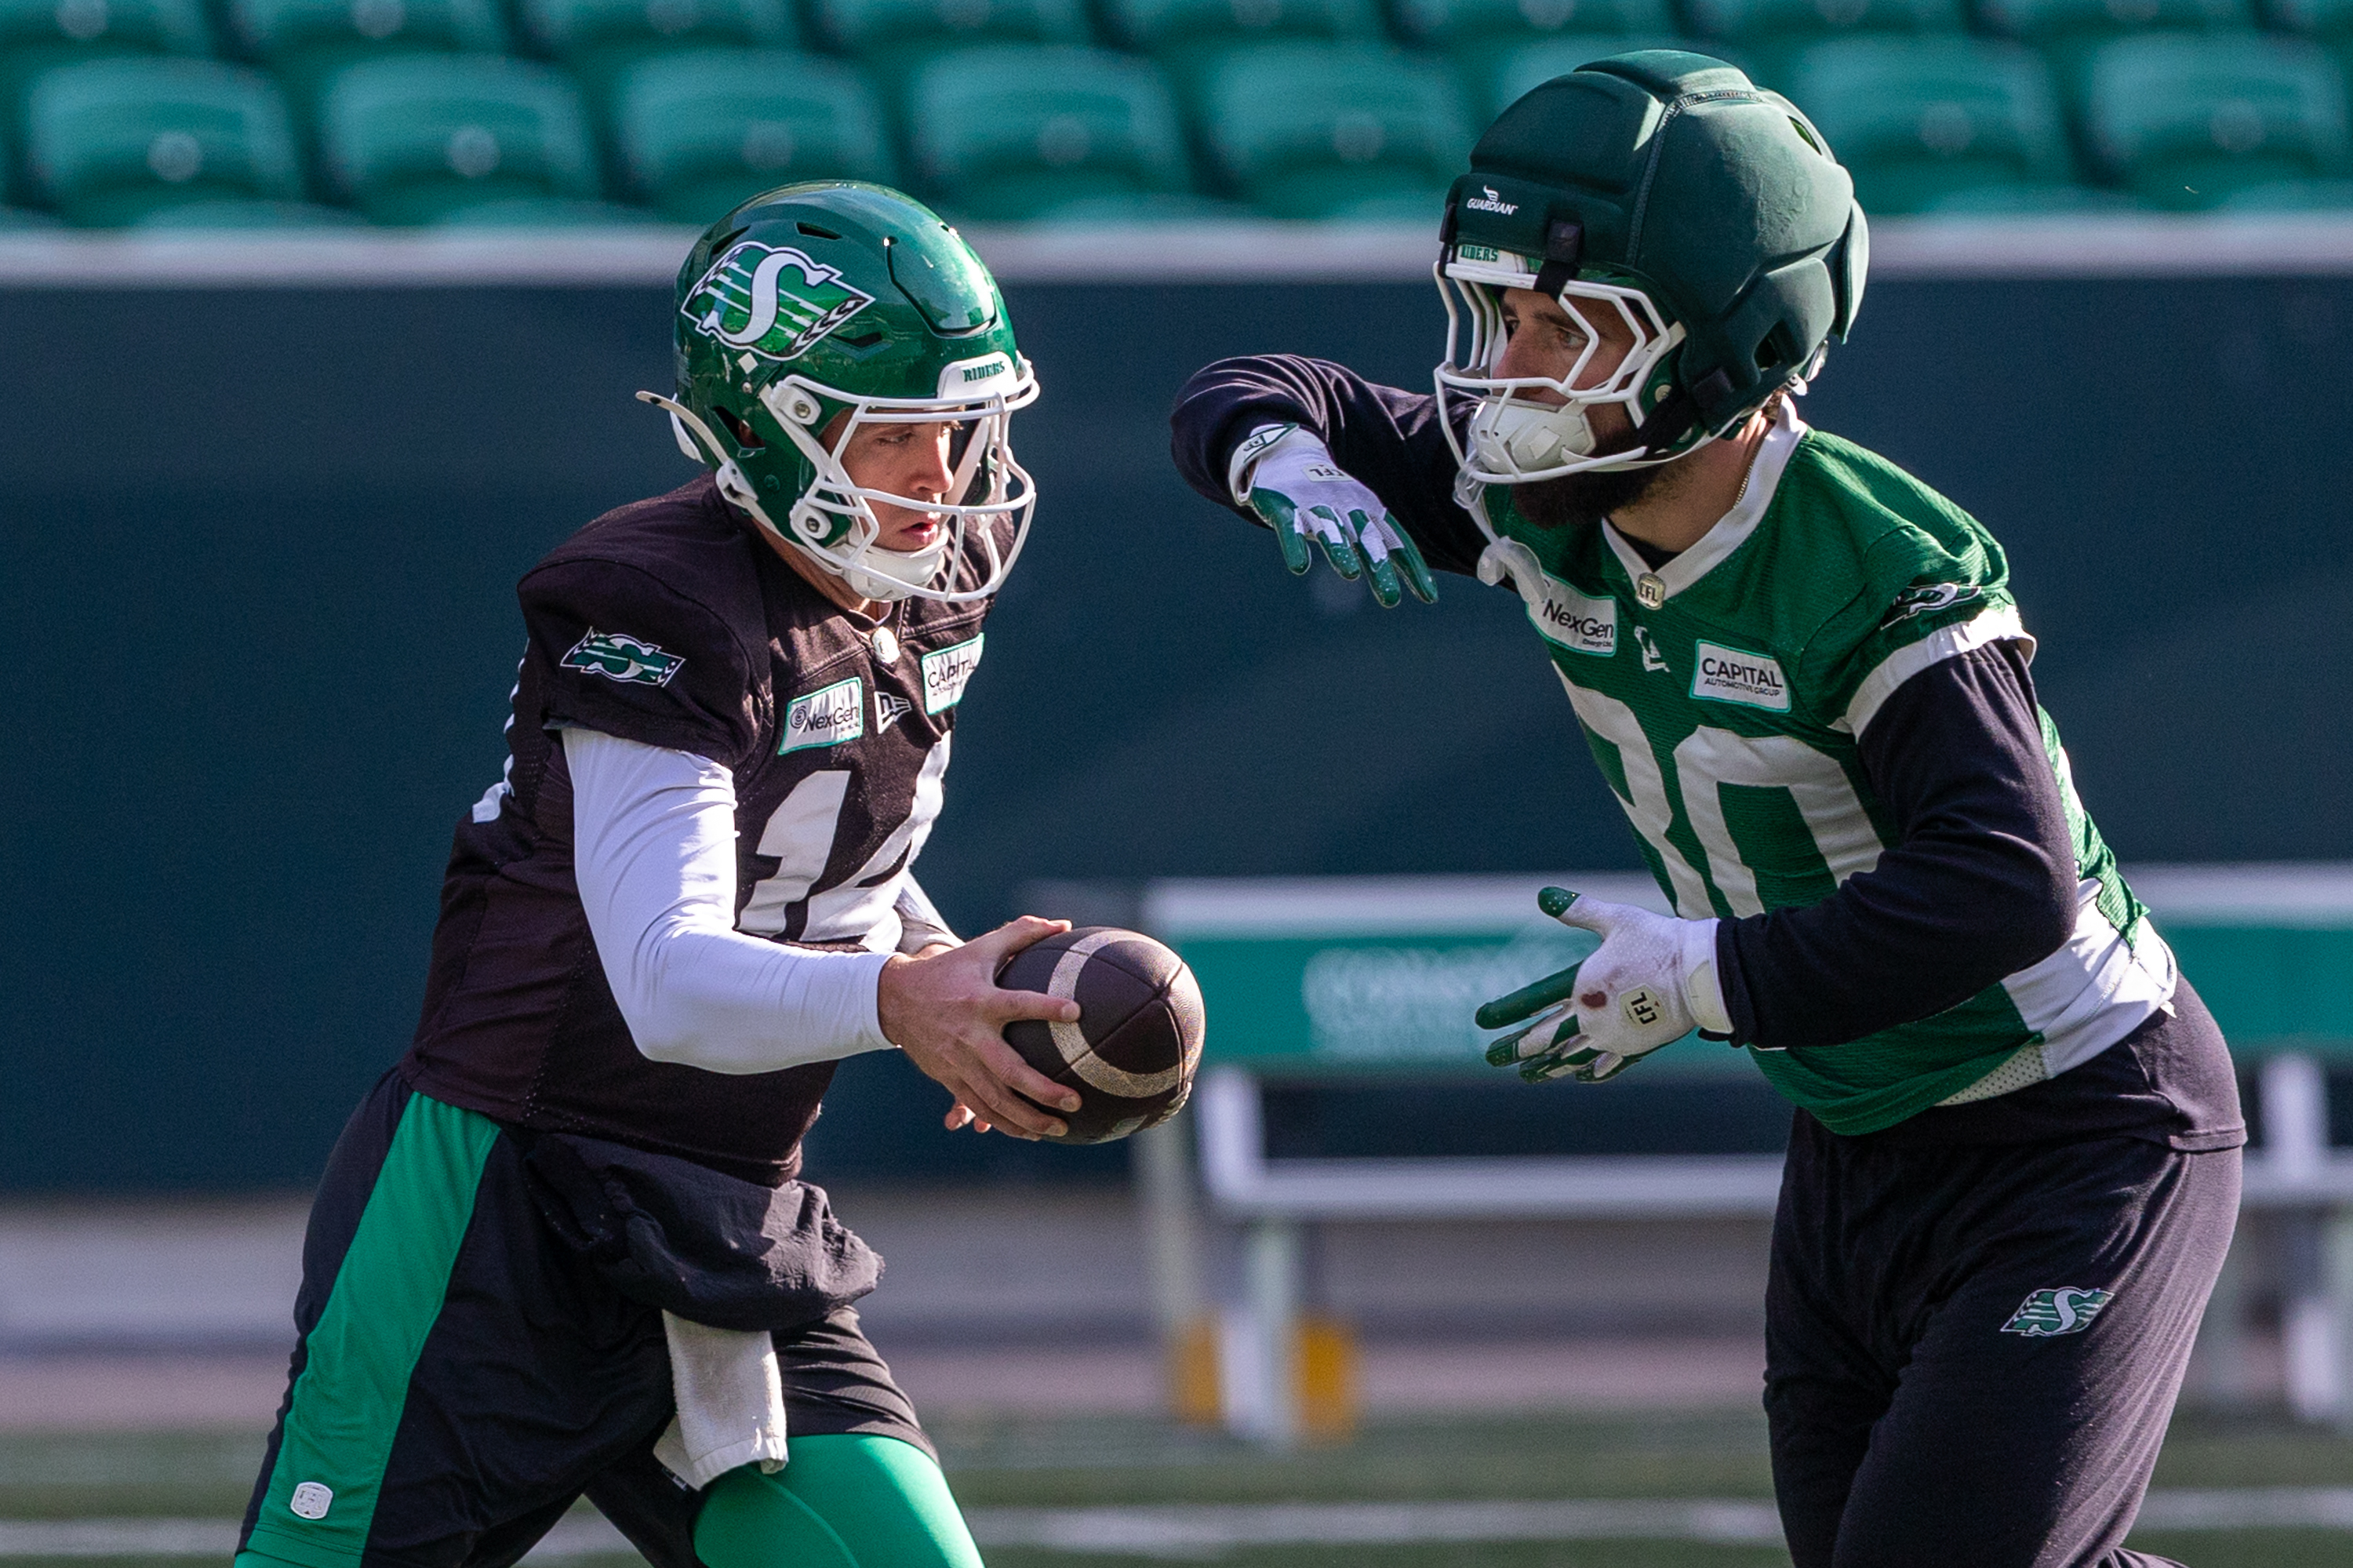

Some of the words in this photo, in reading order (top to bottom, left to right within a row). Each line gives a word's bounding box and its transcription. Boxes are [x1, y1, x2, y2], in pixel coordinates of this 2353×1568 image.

[1467, 198, 1515, 215] GUARDIAN
[962, 361, 1005, 383] RIDERS
[1542, 598, 1614, 638] NexGen
[1701, 657, 1784, 688] CAPITAL
[1631, 991, 1657, 1024] CFL
